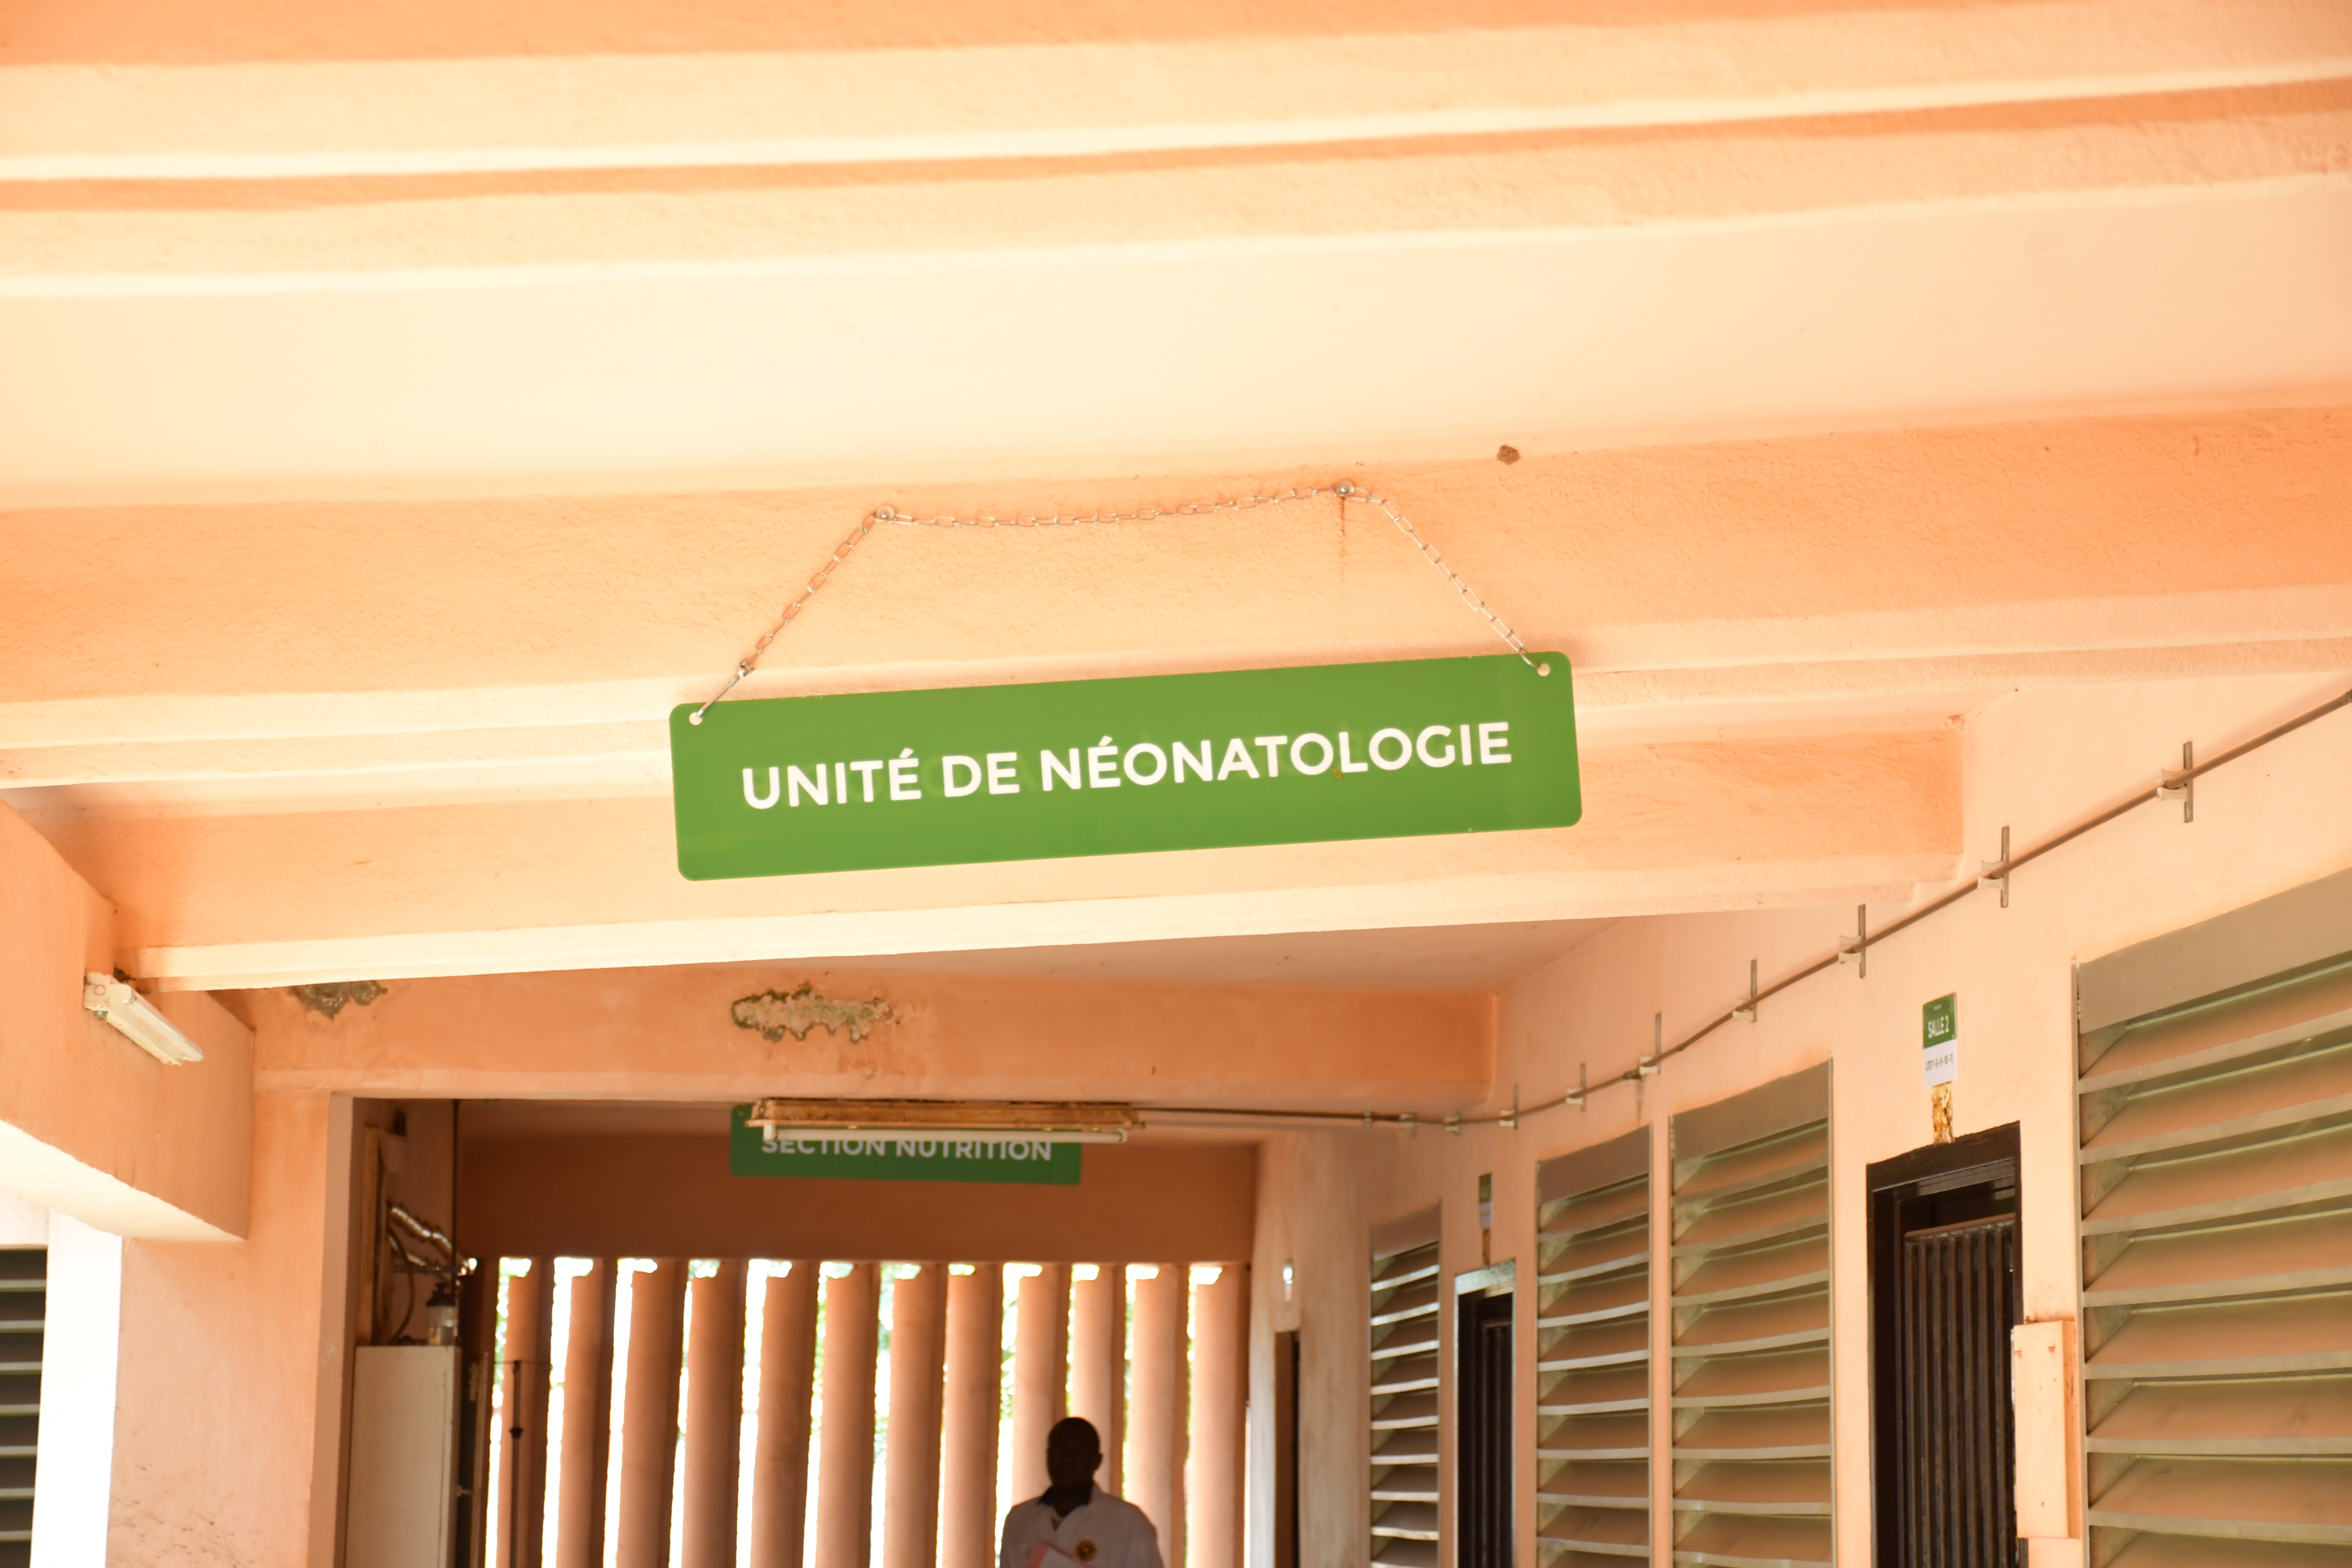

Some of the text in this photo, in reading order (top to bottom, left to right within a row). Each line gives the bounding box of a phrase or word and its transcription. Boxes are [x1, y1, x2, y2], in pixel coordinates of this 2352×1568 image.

[743, 722, 1511, 809] UNITÉ DE NÉONATOLOGIE
[1945, 1015, 1949, 1033] 2
[896, 1140, 1051, 1161] NUTRITION
